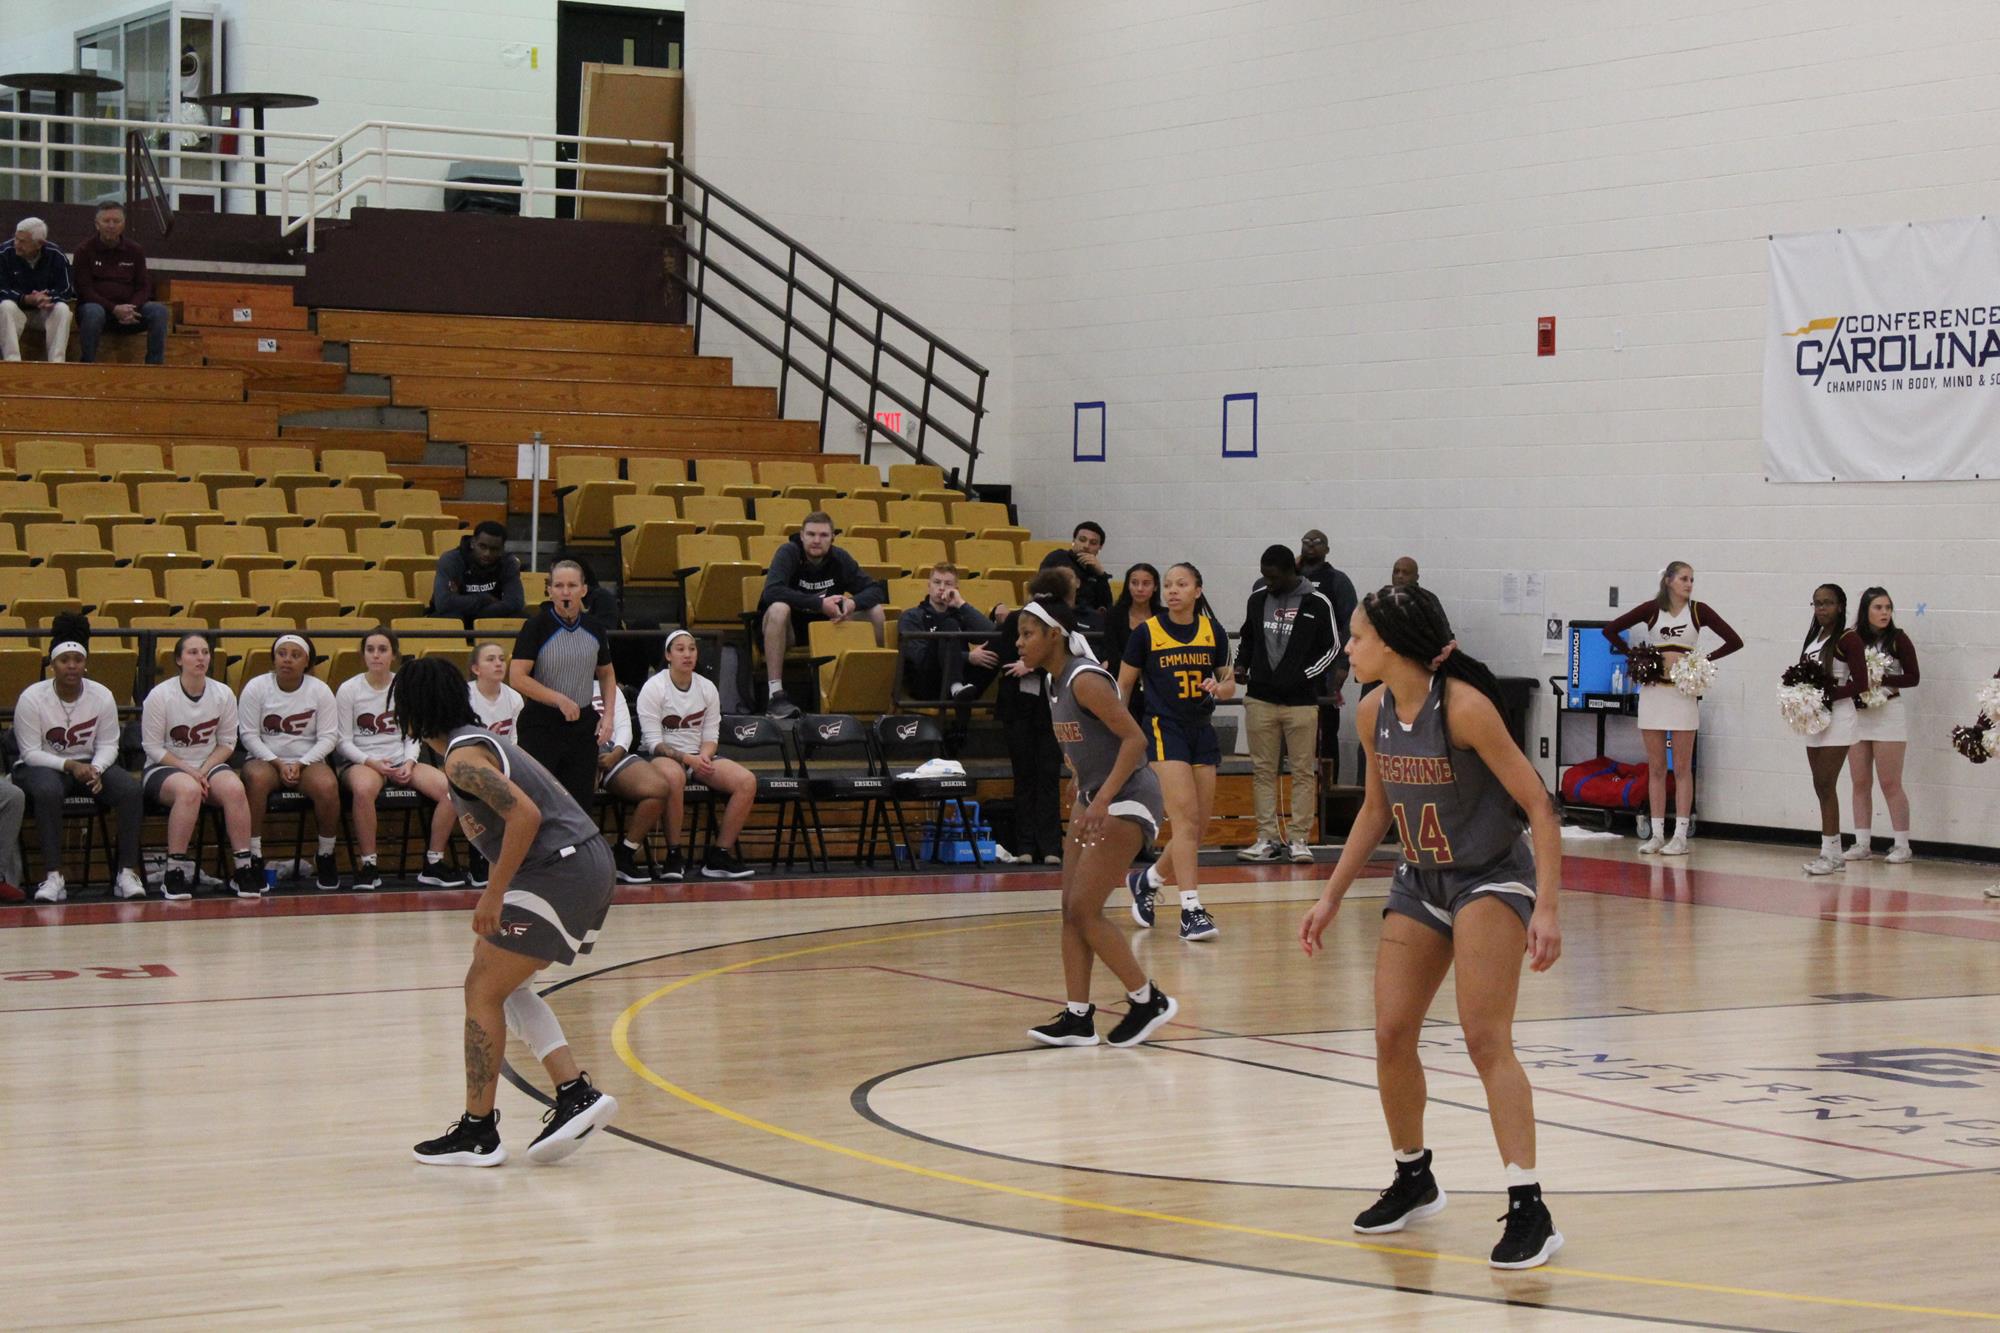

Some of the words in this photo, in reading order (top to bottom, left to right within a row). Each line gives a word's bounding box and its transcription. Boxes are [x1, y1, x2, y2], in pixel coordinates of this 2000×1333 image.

[1846, 306, 2000, 334] CONFERENCE
[1796, 328, 2000, 386] CAROLINA
[1827, 378, 1887, 393] CHAMPIONS
[1892, 378, 1903, 391] IN
[1908, 376, 1938, 391] BODY,
[1943, 375, 1973, 389] MIND
[1160, 653, 1211, 668] EMMANUEL
[1174, 670, 1202, 699] 32
[1392, 803, 1453, 863] 14
